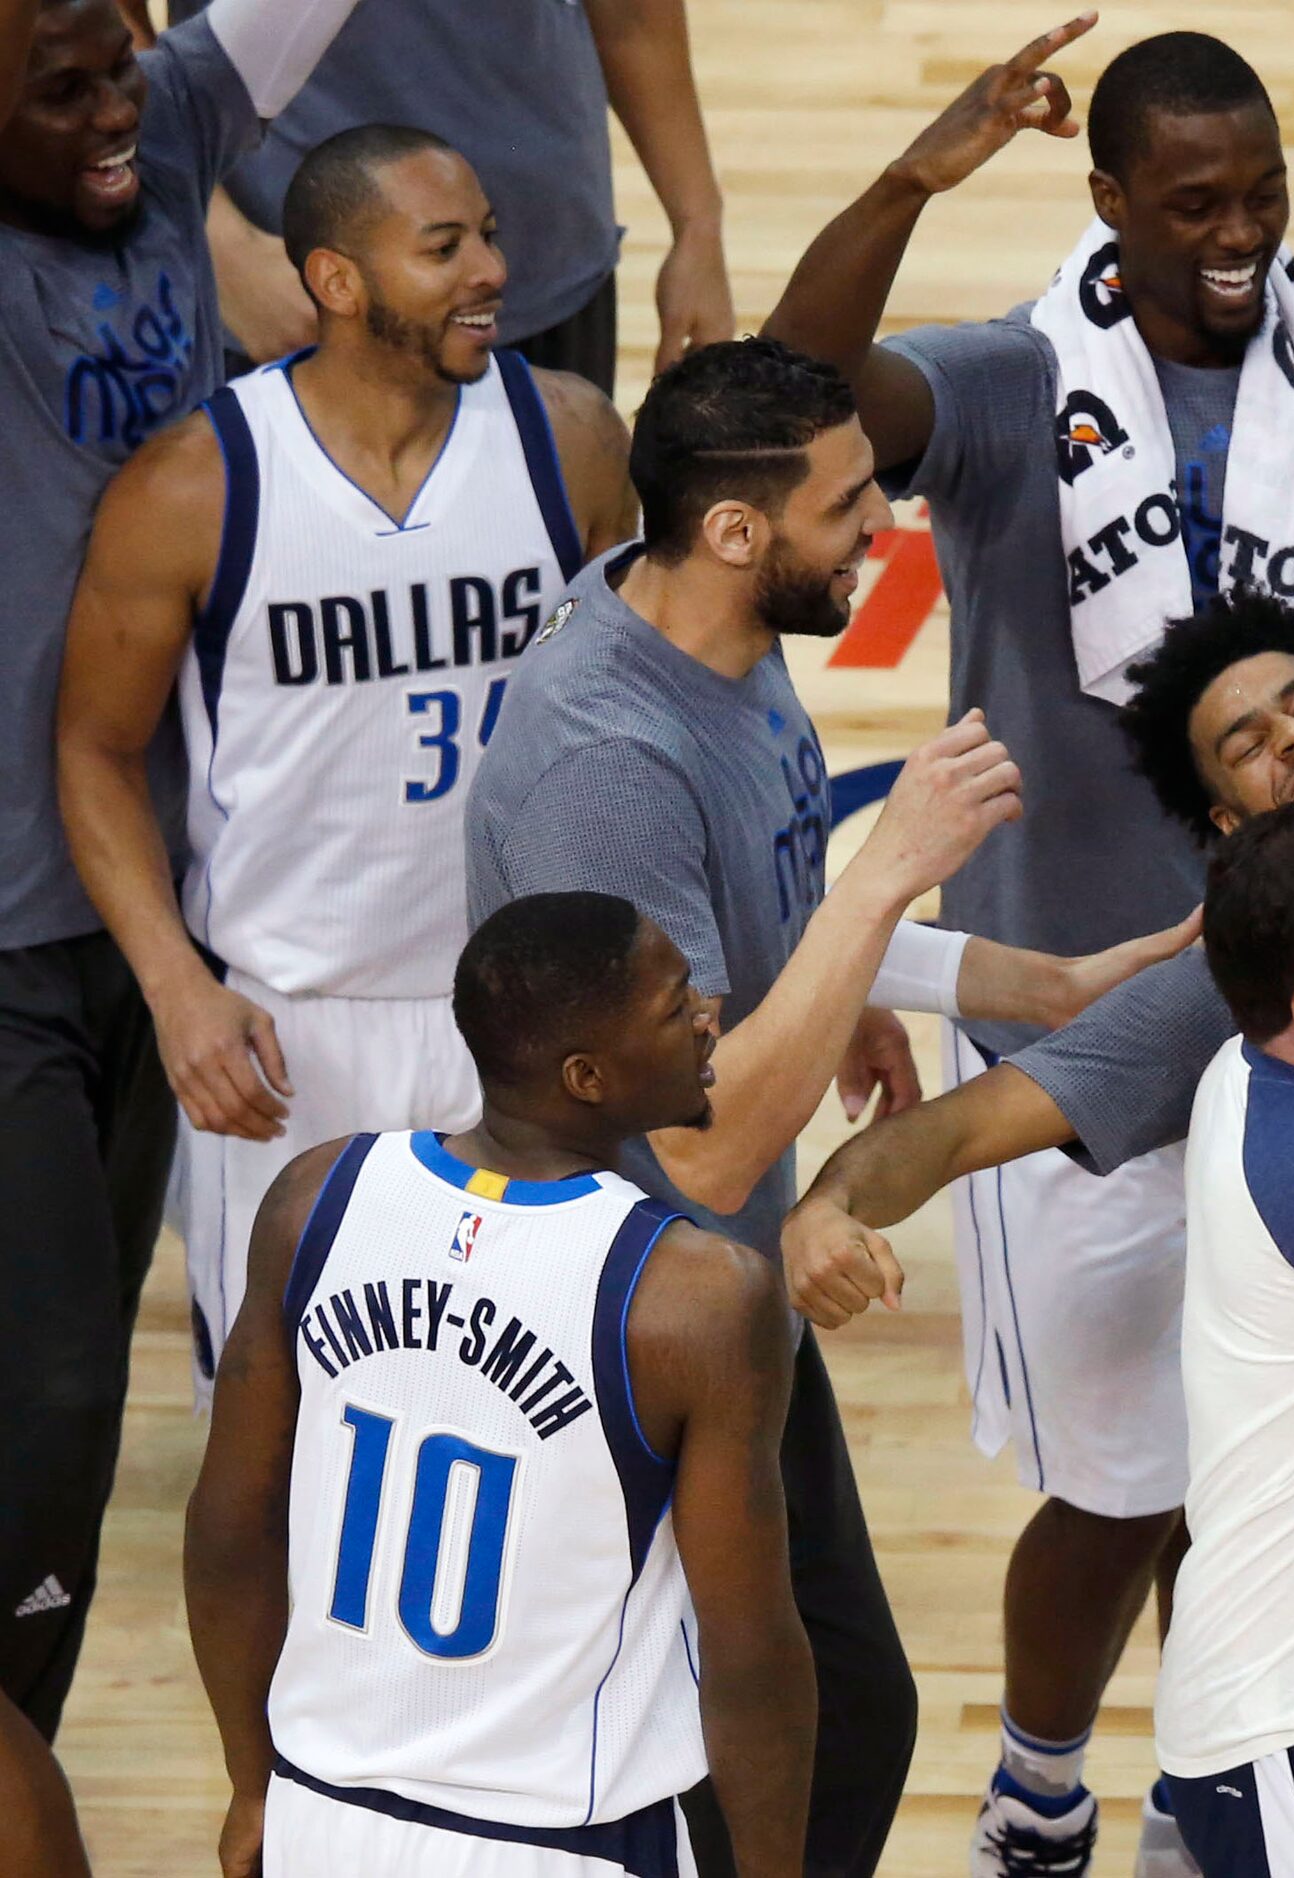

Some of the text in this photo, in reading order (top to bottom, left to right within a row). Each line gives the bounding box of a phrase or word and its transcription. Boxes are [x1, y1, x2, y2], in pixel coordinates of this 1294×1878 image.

[1067, 480, 1182, 606] ATO
[266, 566, 541, 686] DALLAS
[300, 1279, 593, 1441] FINNEY-SMITH
[326, 1401, 522, 1660] 10
